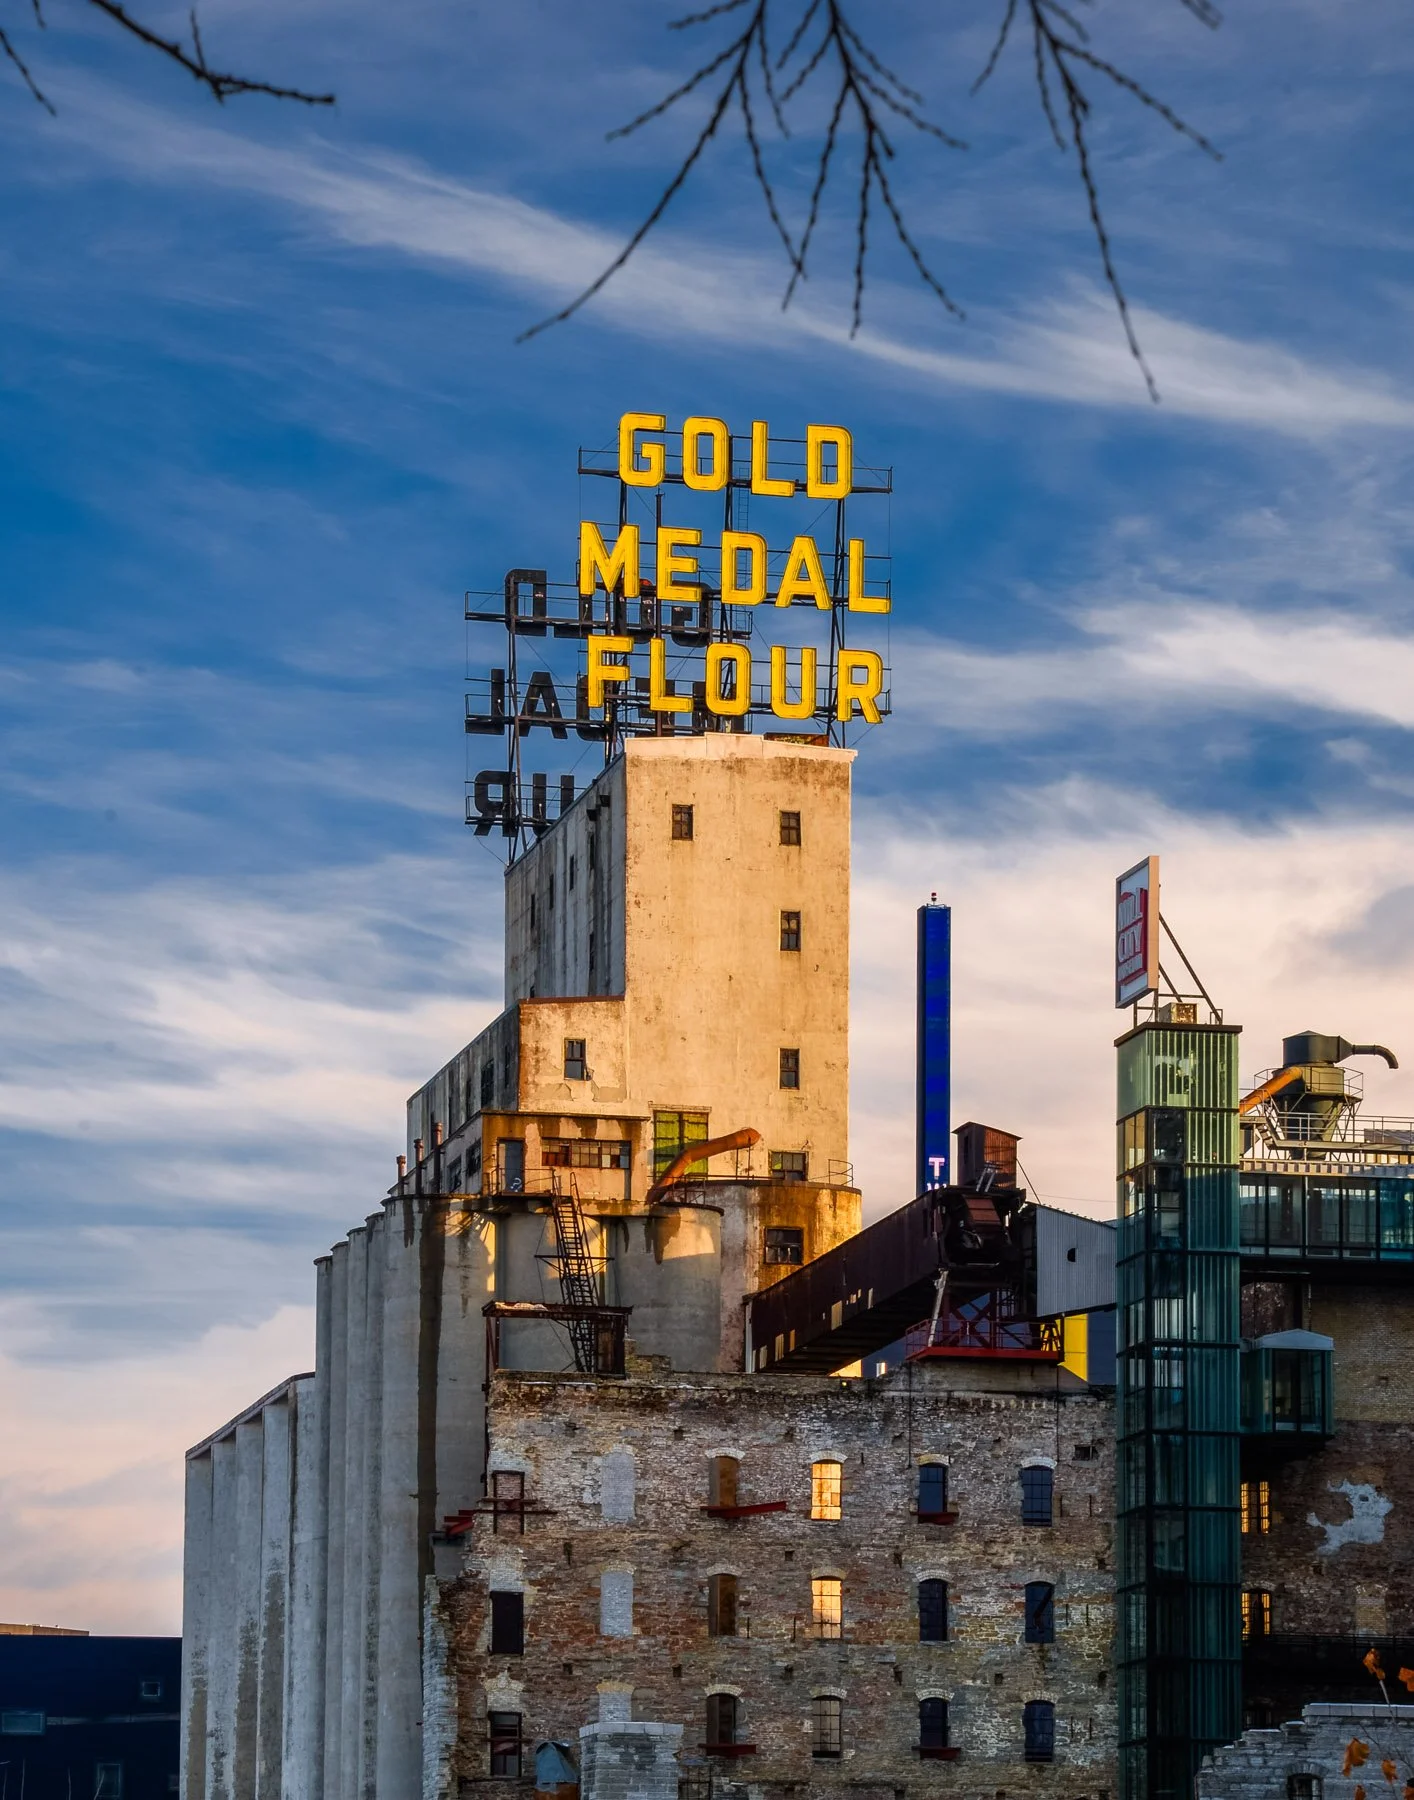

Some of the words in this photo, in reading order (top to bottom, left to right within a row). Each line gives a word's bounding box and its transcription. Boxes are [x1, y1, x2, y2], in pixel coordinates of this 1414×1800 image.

[617, 412, 852, 500] GOLD
[578, 520, 891, 615] MEDAL
[586, 633, 883, 725] FLOUR
